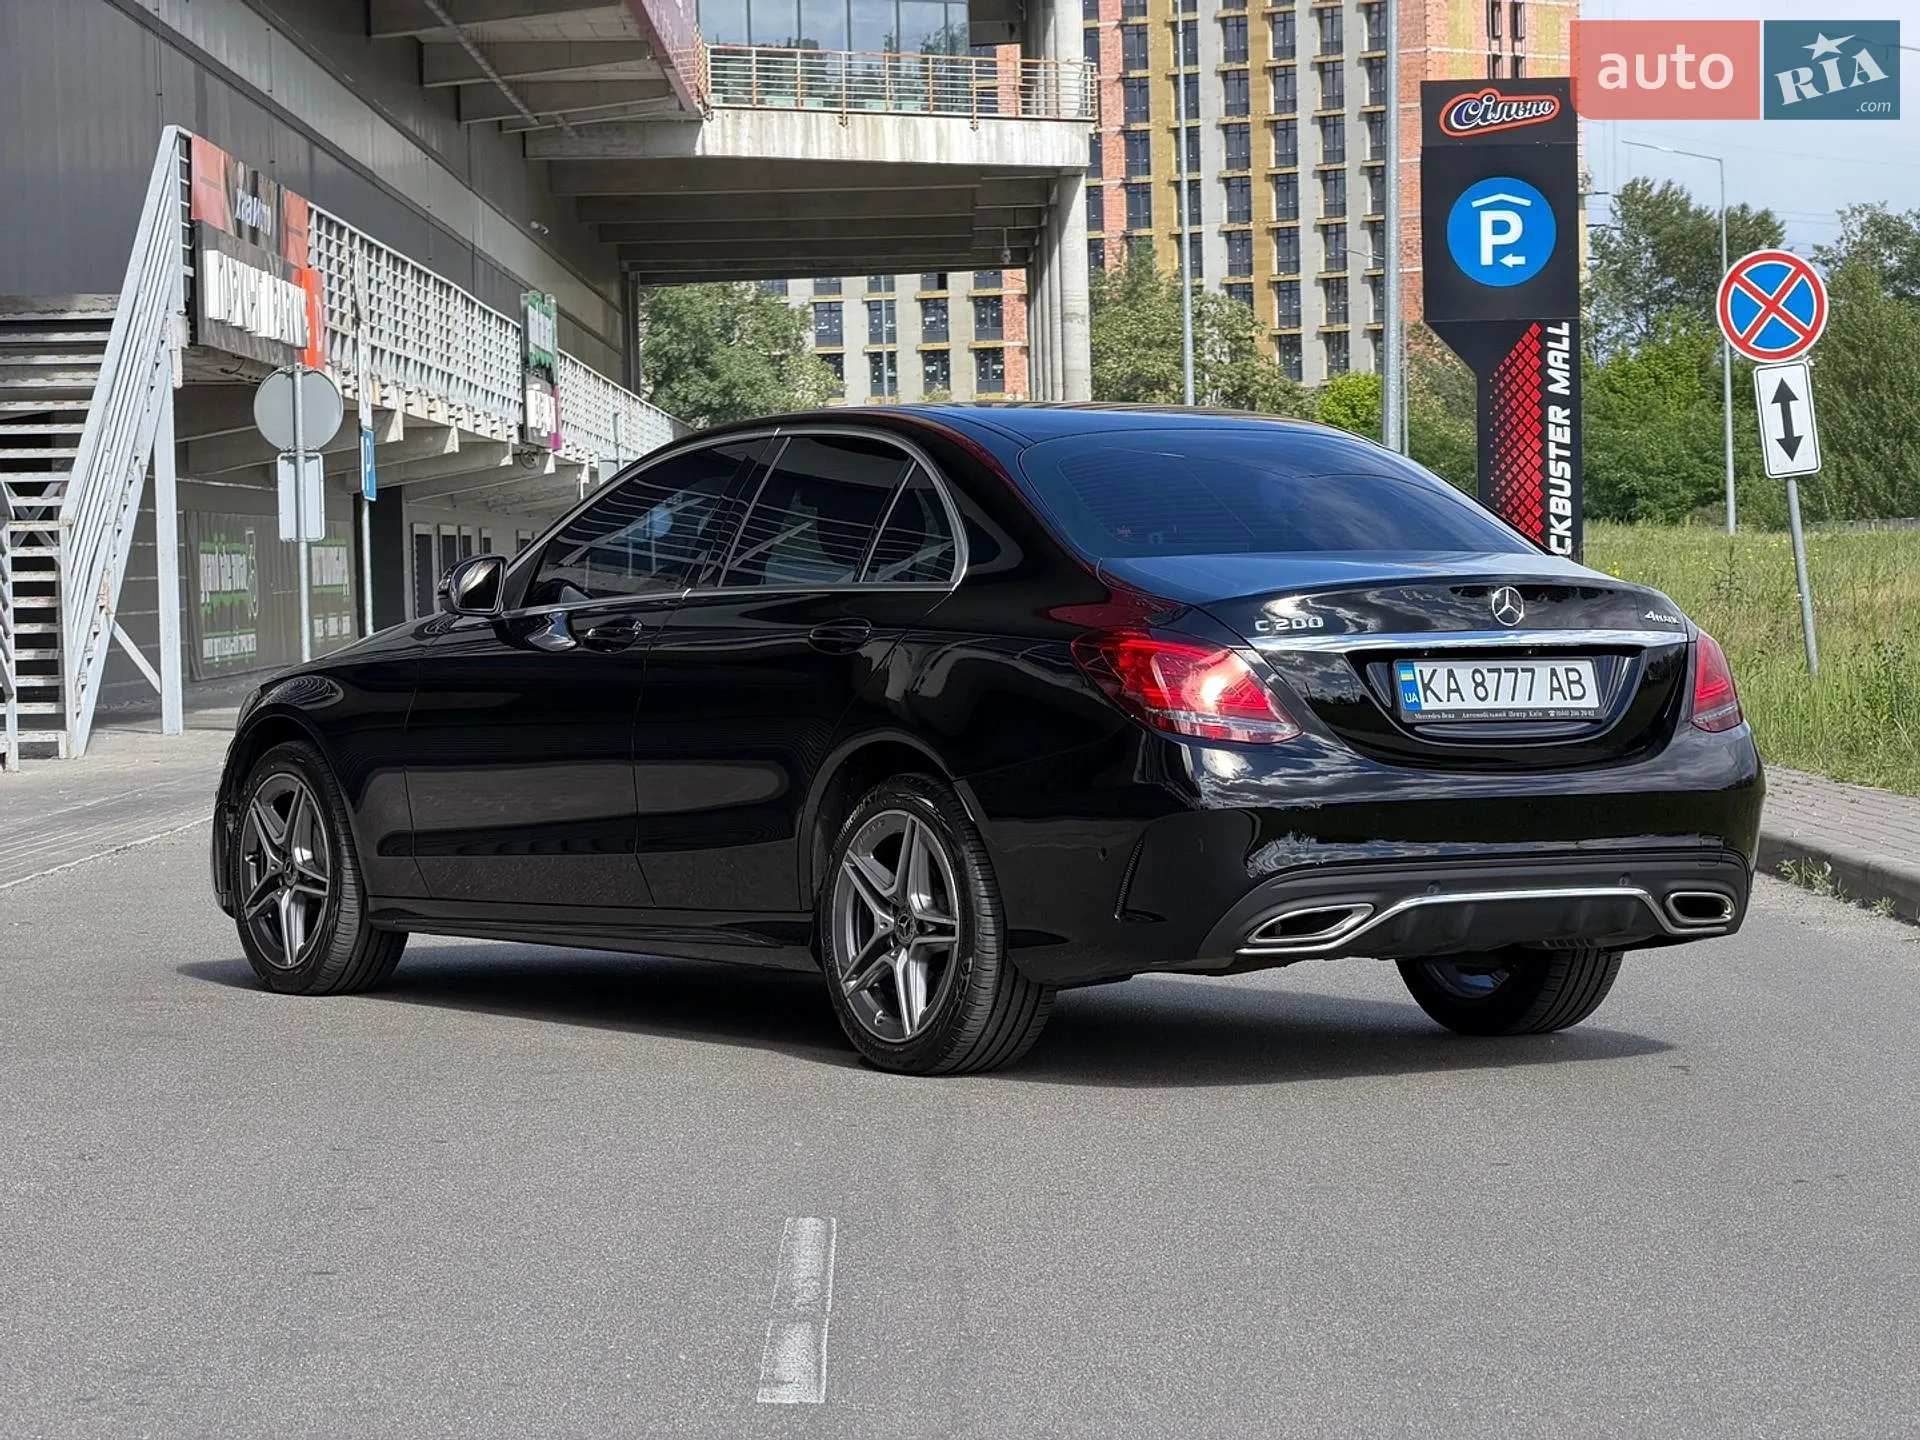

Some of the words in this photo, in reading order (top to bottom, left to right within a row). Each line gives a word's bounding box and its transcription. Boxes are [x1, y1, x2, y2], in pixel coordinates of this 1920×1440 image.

[1479, 210, 1523, 266] P
[1547, 322, 1570, 395] MALL
[1405, 693, 1419, 702] UA
[1418, 668, 1465, 702] KA
[1470, 667, 1536, 702] 8777
[1549, 667, 1587, 701] AB
